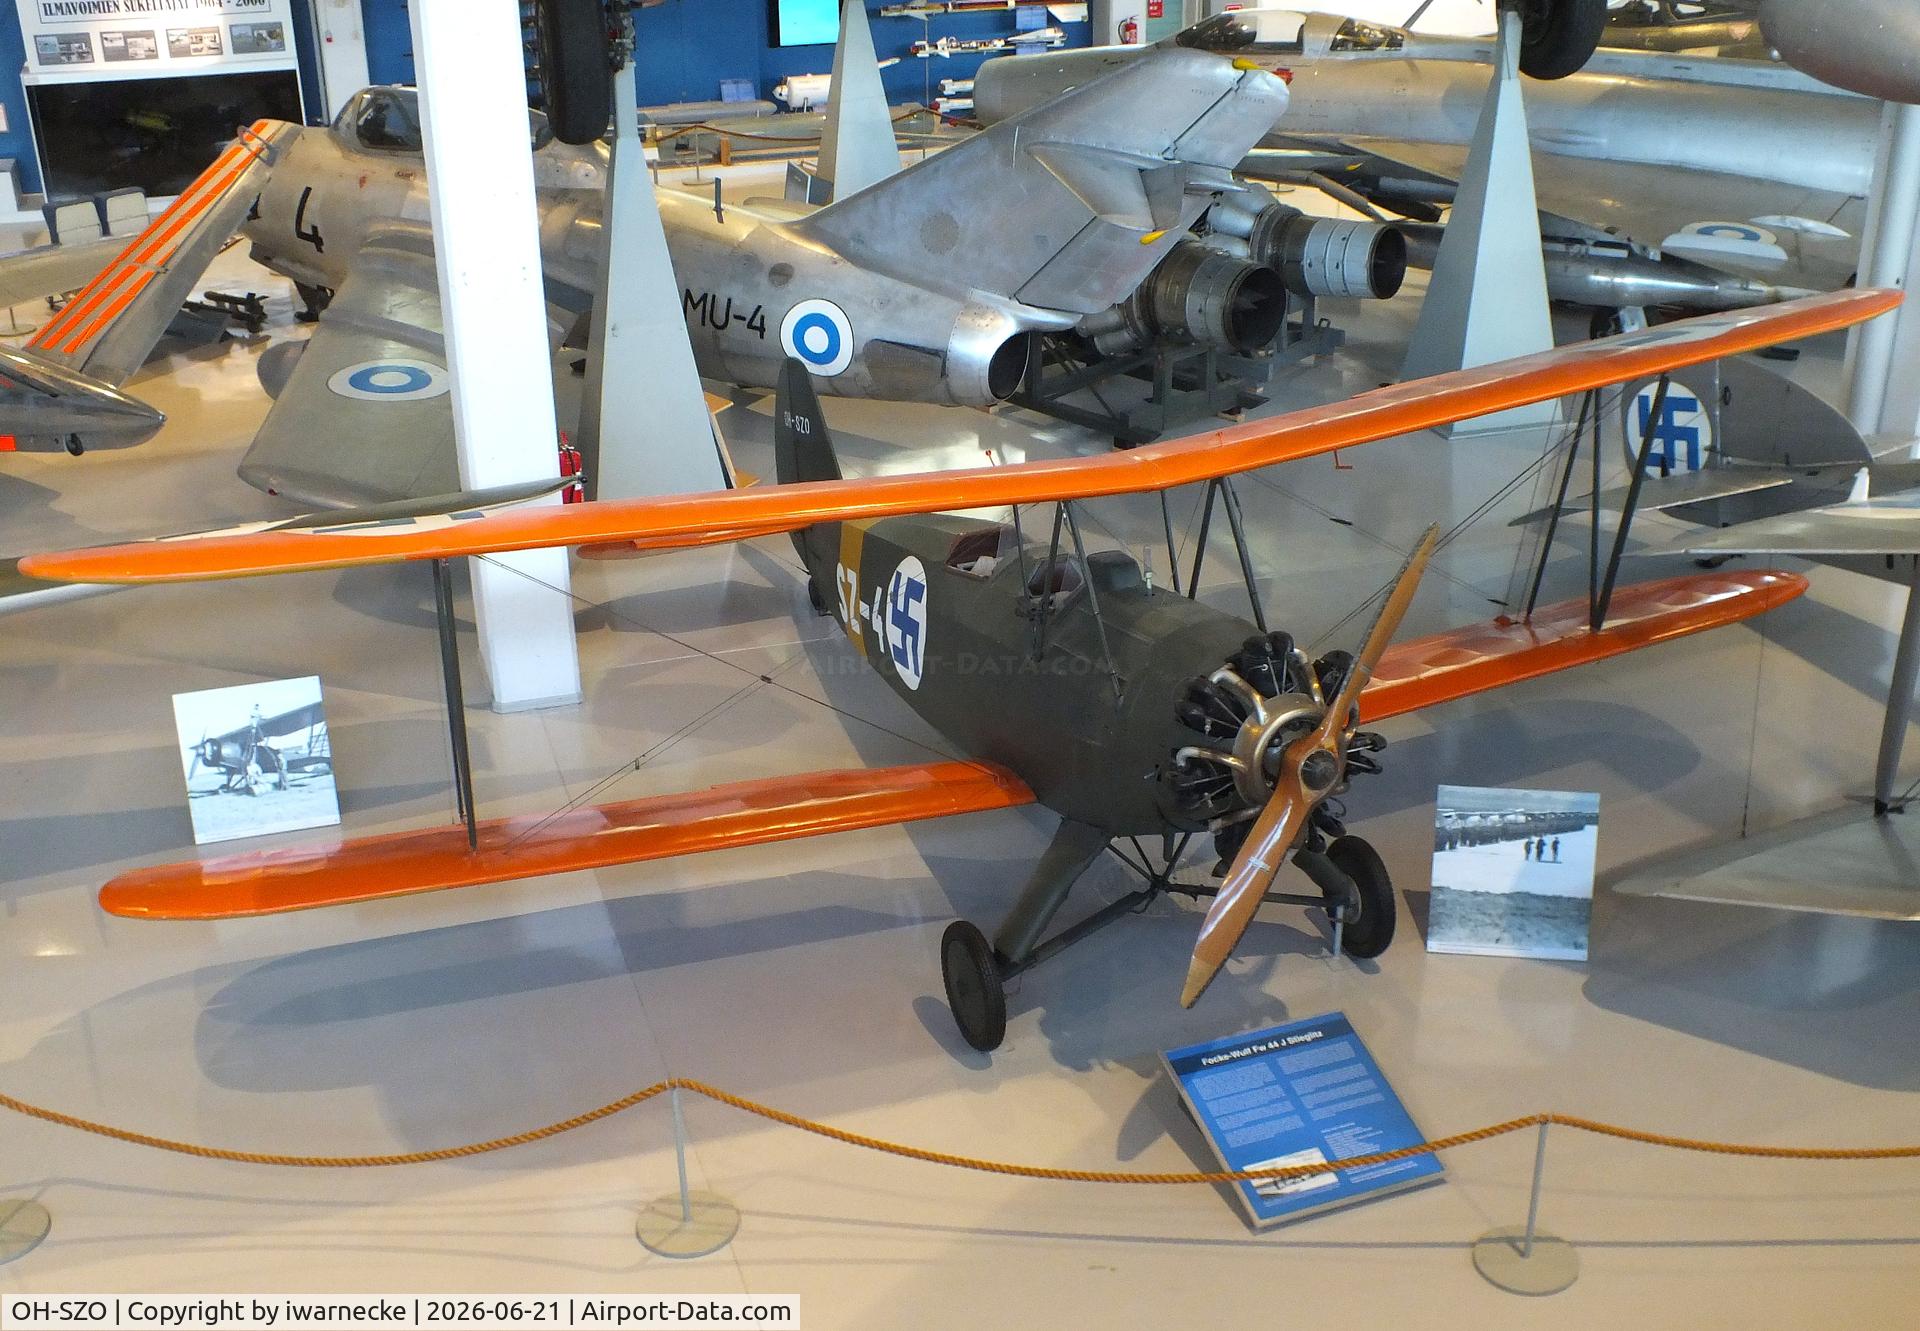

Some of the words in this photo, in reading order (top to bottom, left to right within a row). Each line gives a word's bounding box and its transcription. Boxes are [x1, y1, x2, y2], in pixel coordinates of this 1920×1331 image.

[42, 1, 121, 16] ILMAVOIMIEN
[683, 288, 766, 340] MU-4
[836, 562, 885, 654] SZ-4
[1267, 1040, 1280, 1049] 44
